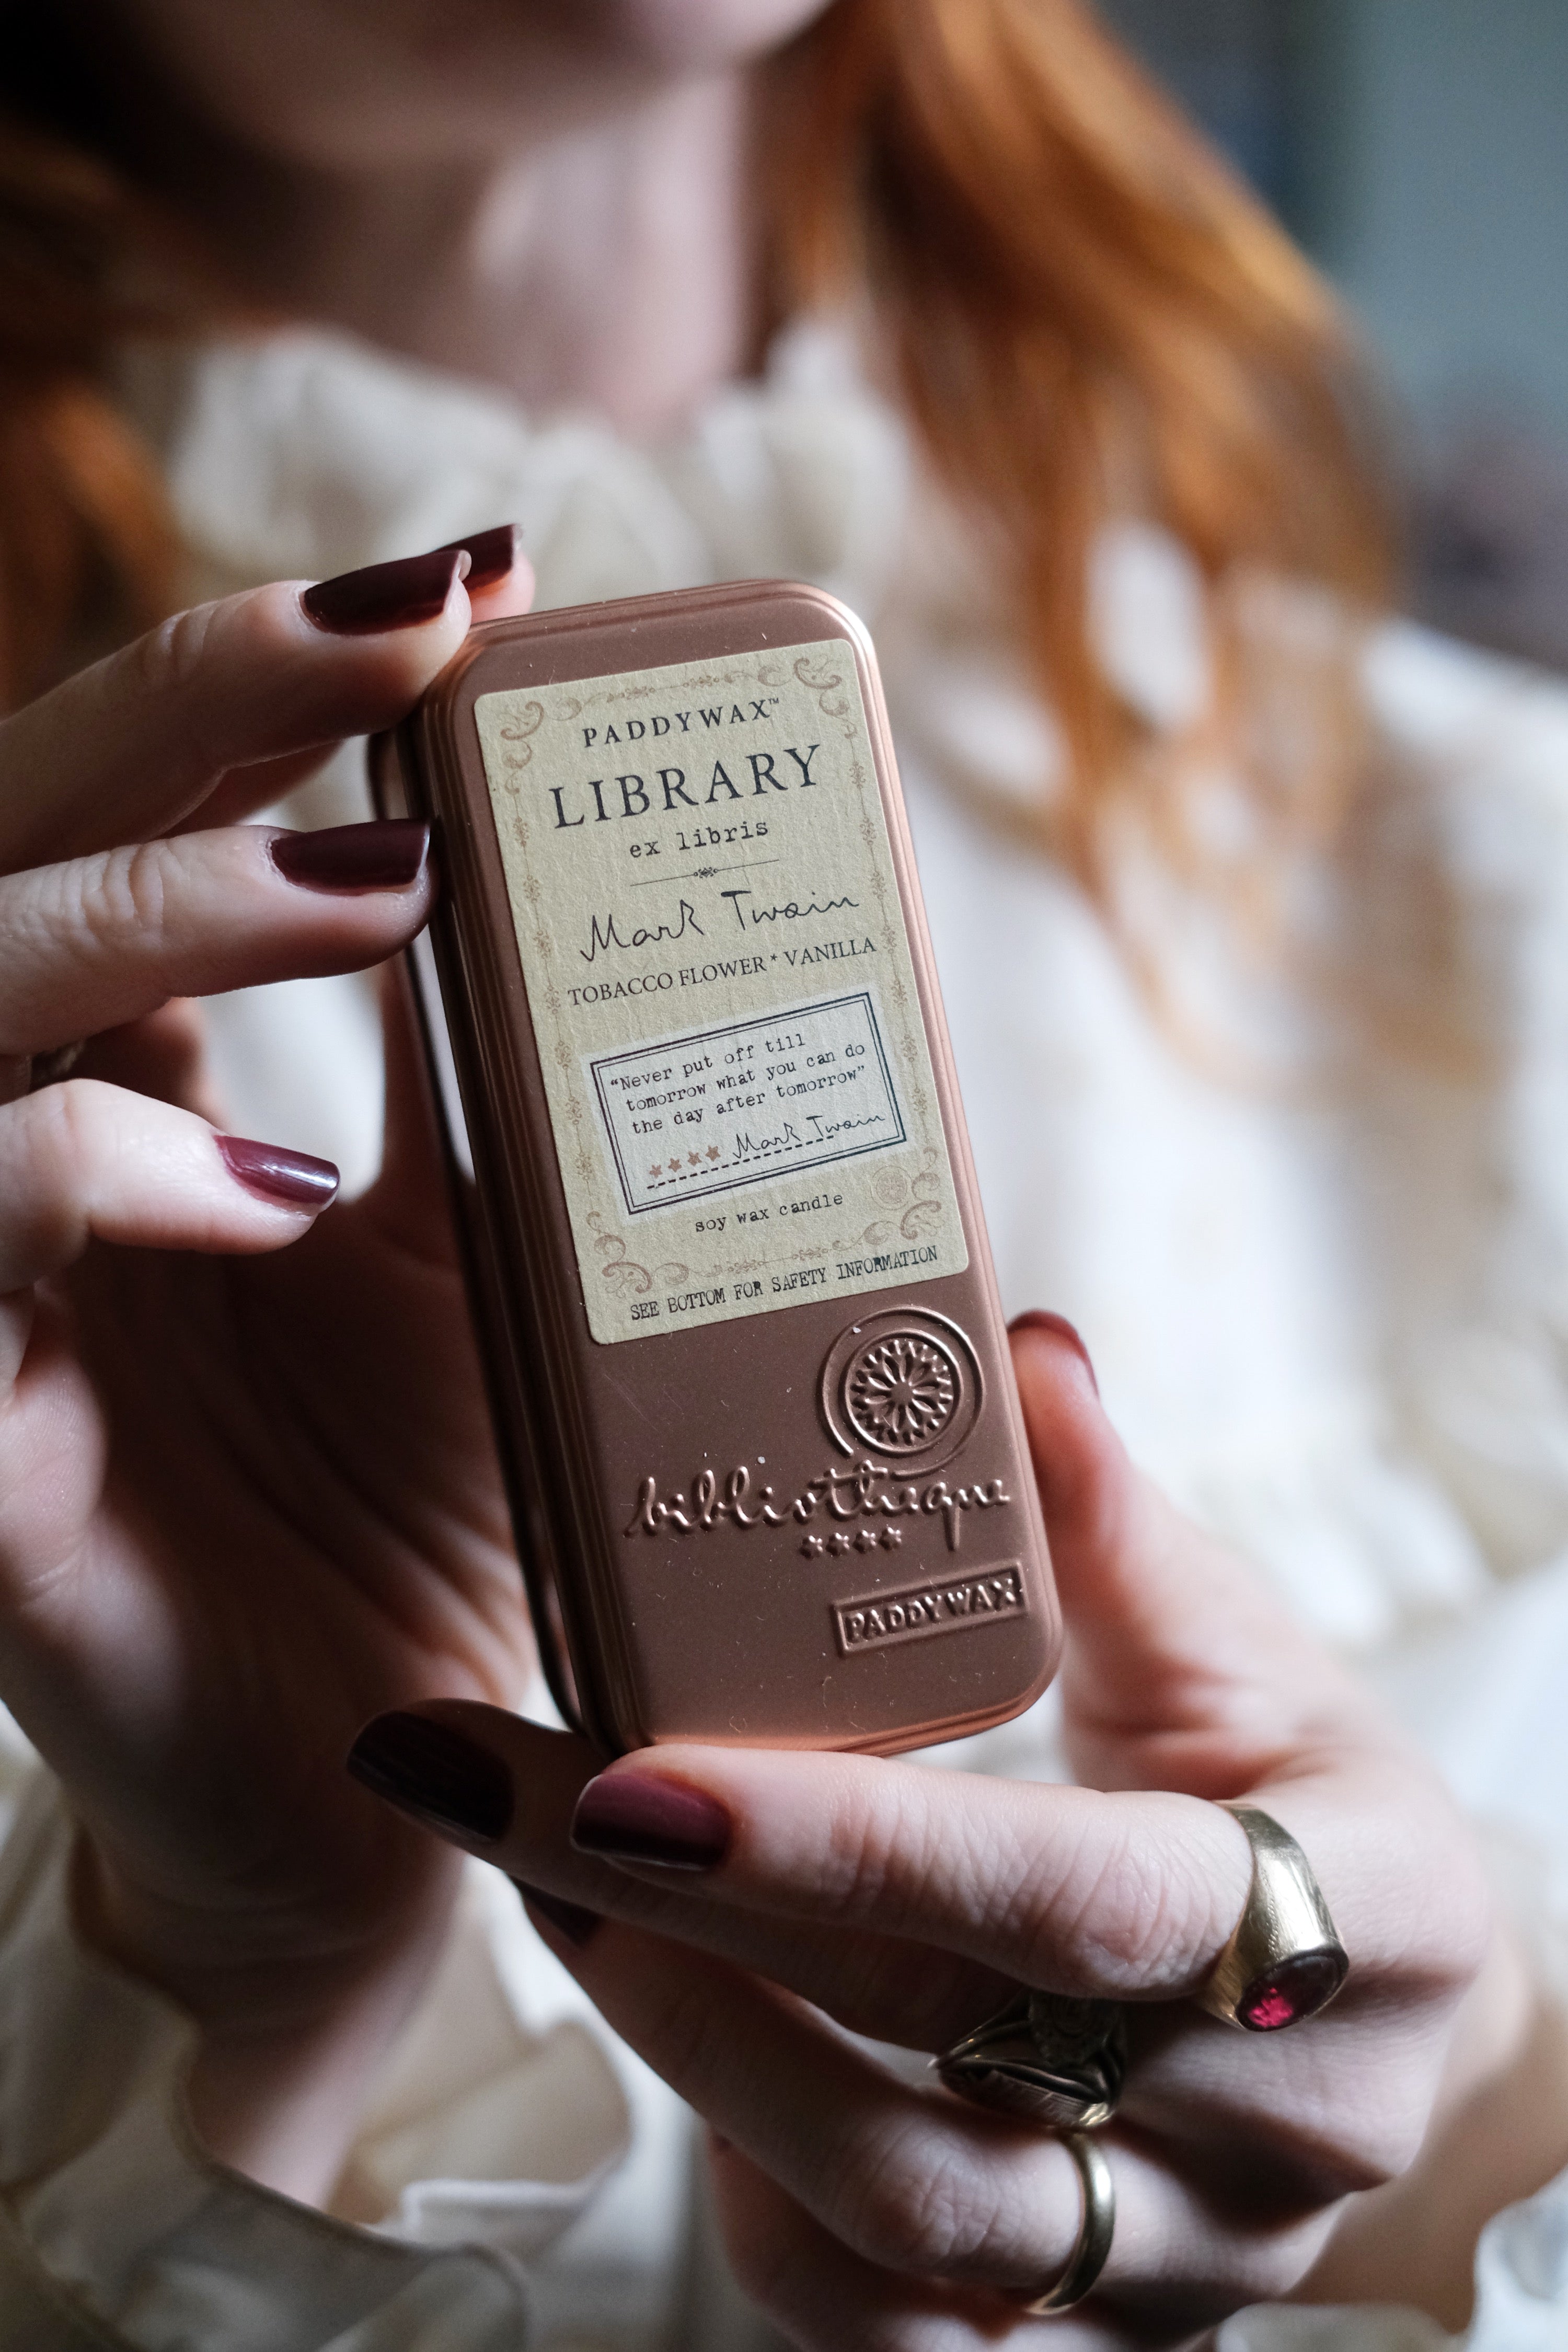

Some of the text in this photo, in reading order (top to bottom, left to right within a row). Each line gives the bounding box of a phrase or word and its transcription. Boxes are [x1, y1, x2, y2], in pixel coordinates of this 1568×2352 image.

[549, 744, 822, 829] LIBRARY
[629, 820, 769, 859] ex libris
[580, 890, 859, 962] Mark Twain
[568, 938, 877, 1006] TOBACCO FLOWER VANILLA
[626, 1043, 865, 1111] tomorrow what you can do
[683, 1056, 713, 1079] put
[724, 1045, 756, 1065] off
[765, 1033, 805, 1053] till
[631, 1119, 663, 1135] the
[673, 1109, 703, 1128] day
[716, 1092, 766, 1115] after
[733, 1113, 885, 1159] Mark Twain
[695, 1193, 843, 1234] soy wax candle
[631, 1246, 938, 1321] SEE BOTTOM FOR SAFETY INFORMATION
[847, 1578, 1018, 1643] PADDYWAX
